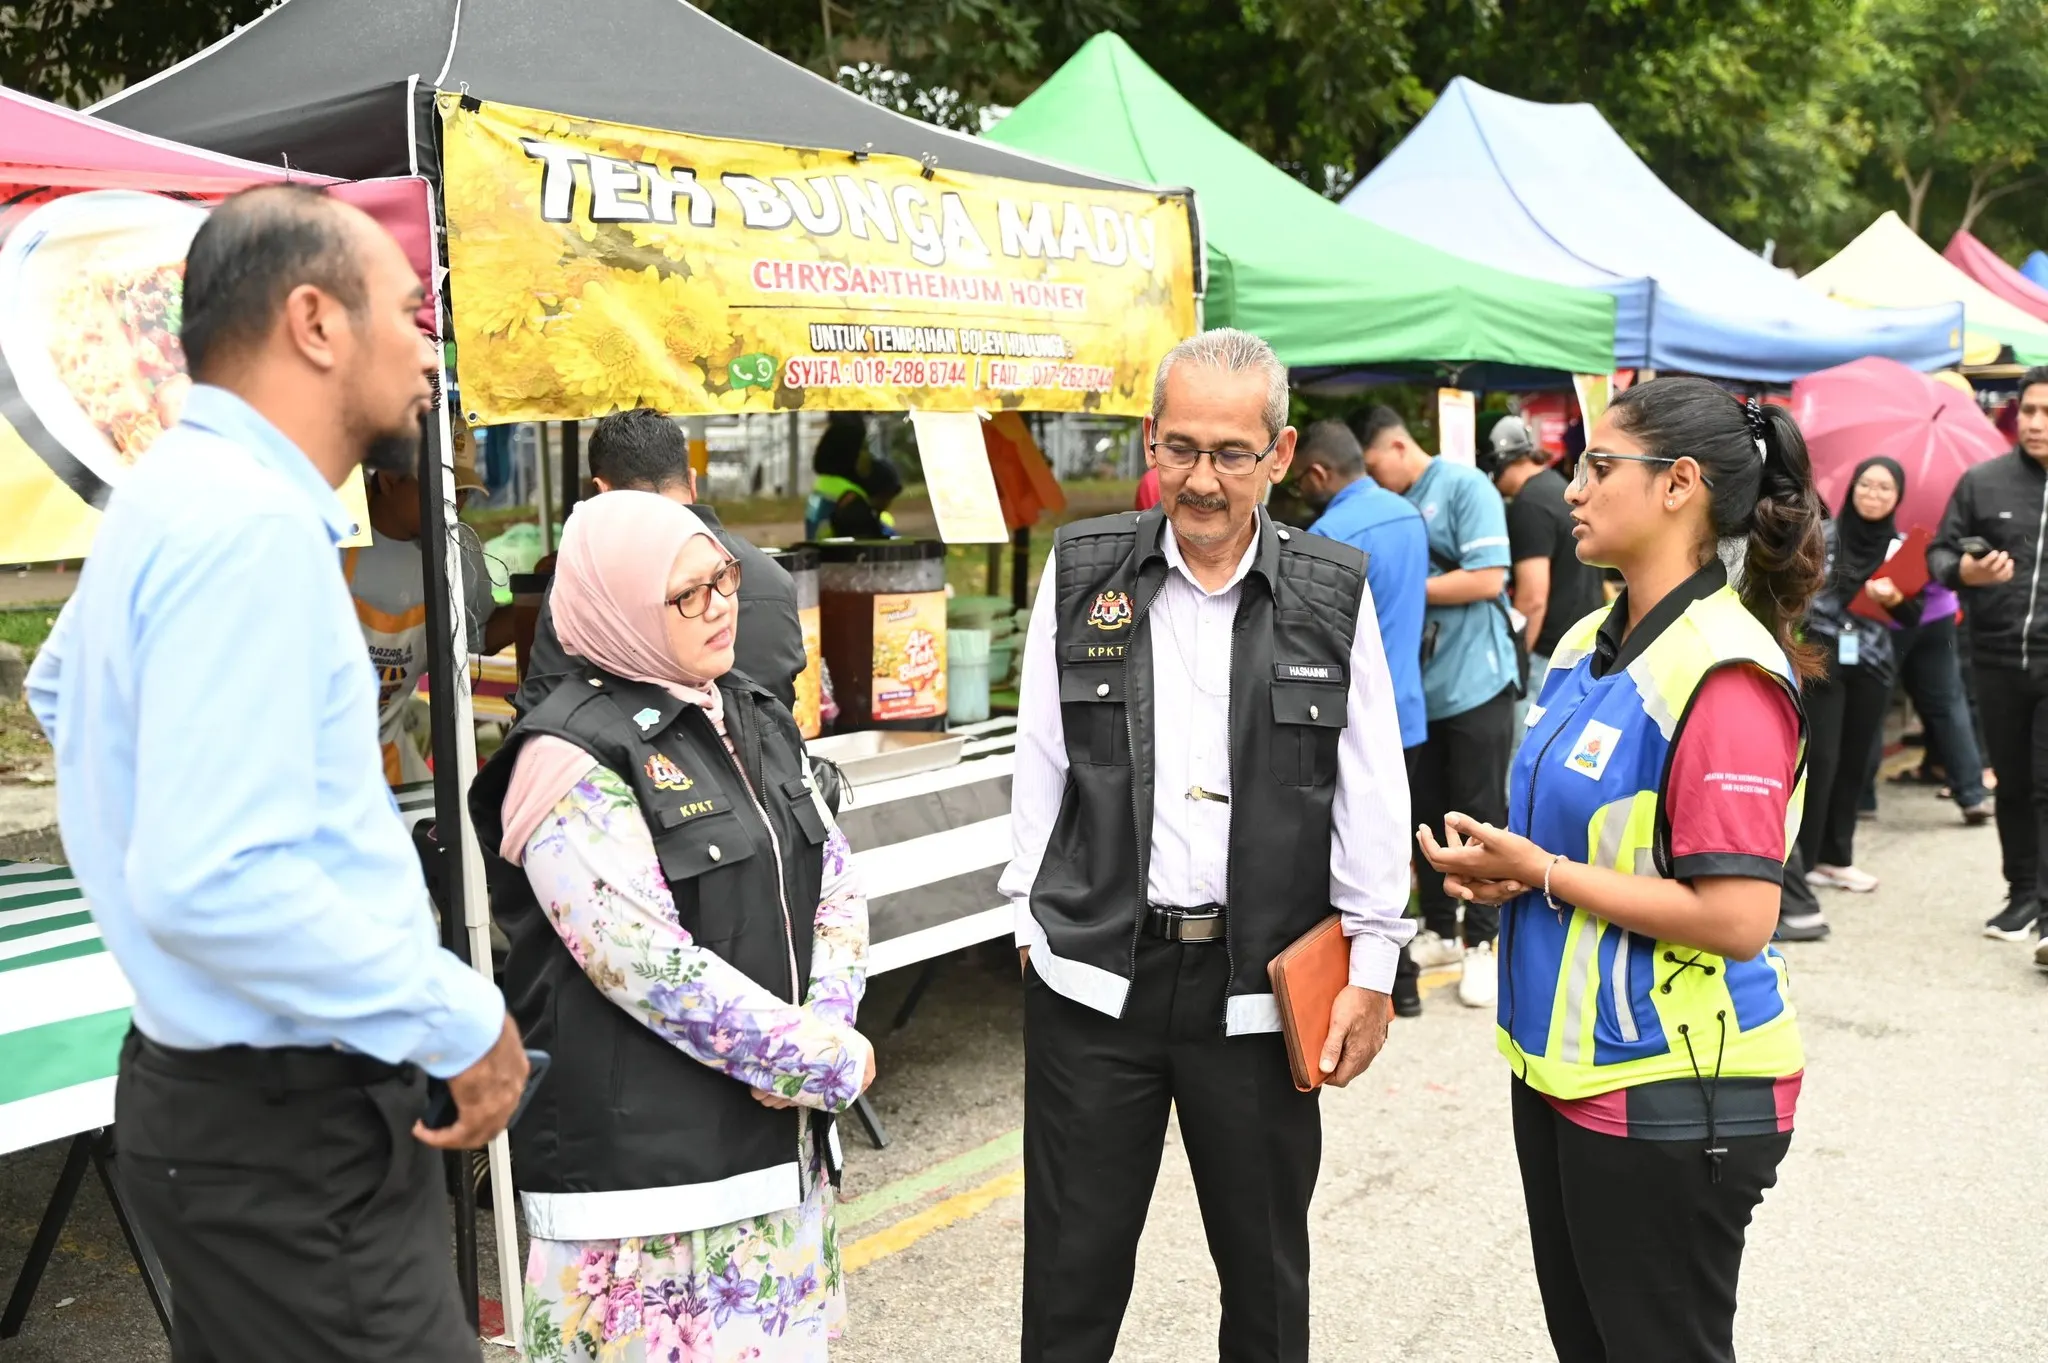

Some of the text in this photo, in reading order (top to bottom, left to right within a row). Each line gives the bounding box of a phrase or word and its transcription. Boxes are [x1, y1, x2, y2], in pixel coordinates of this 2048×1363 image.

[518, 137, 1156, 271] TEH BUNGA MADU
[753, 260, 1085, 309] CHRYSANTHEMUM HONEY
[809, 322, 869, 353] UNTUK
[868, 325, 957, 354] TEMPAHAN
[958, 328, 1005, 356] BOLEH
[786, 359, 841, 385] SYIFA
[991, 363, 1021, 386] FAIZ
[1088, 646, 1124, 657] KPKT
[679, 800, 714, 818] KPKT
